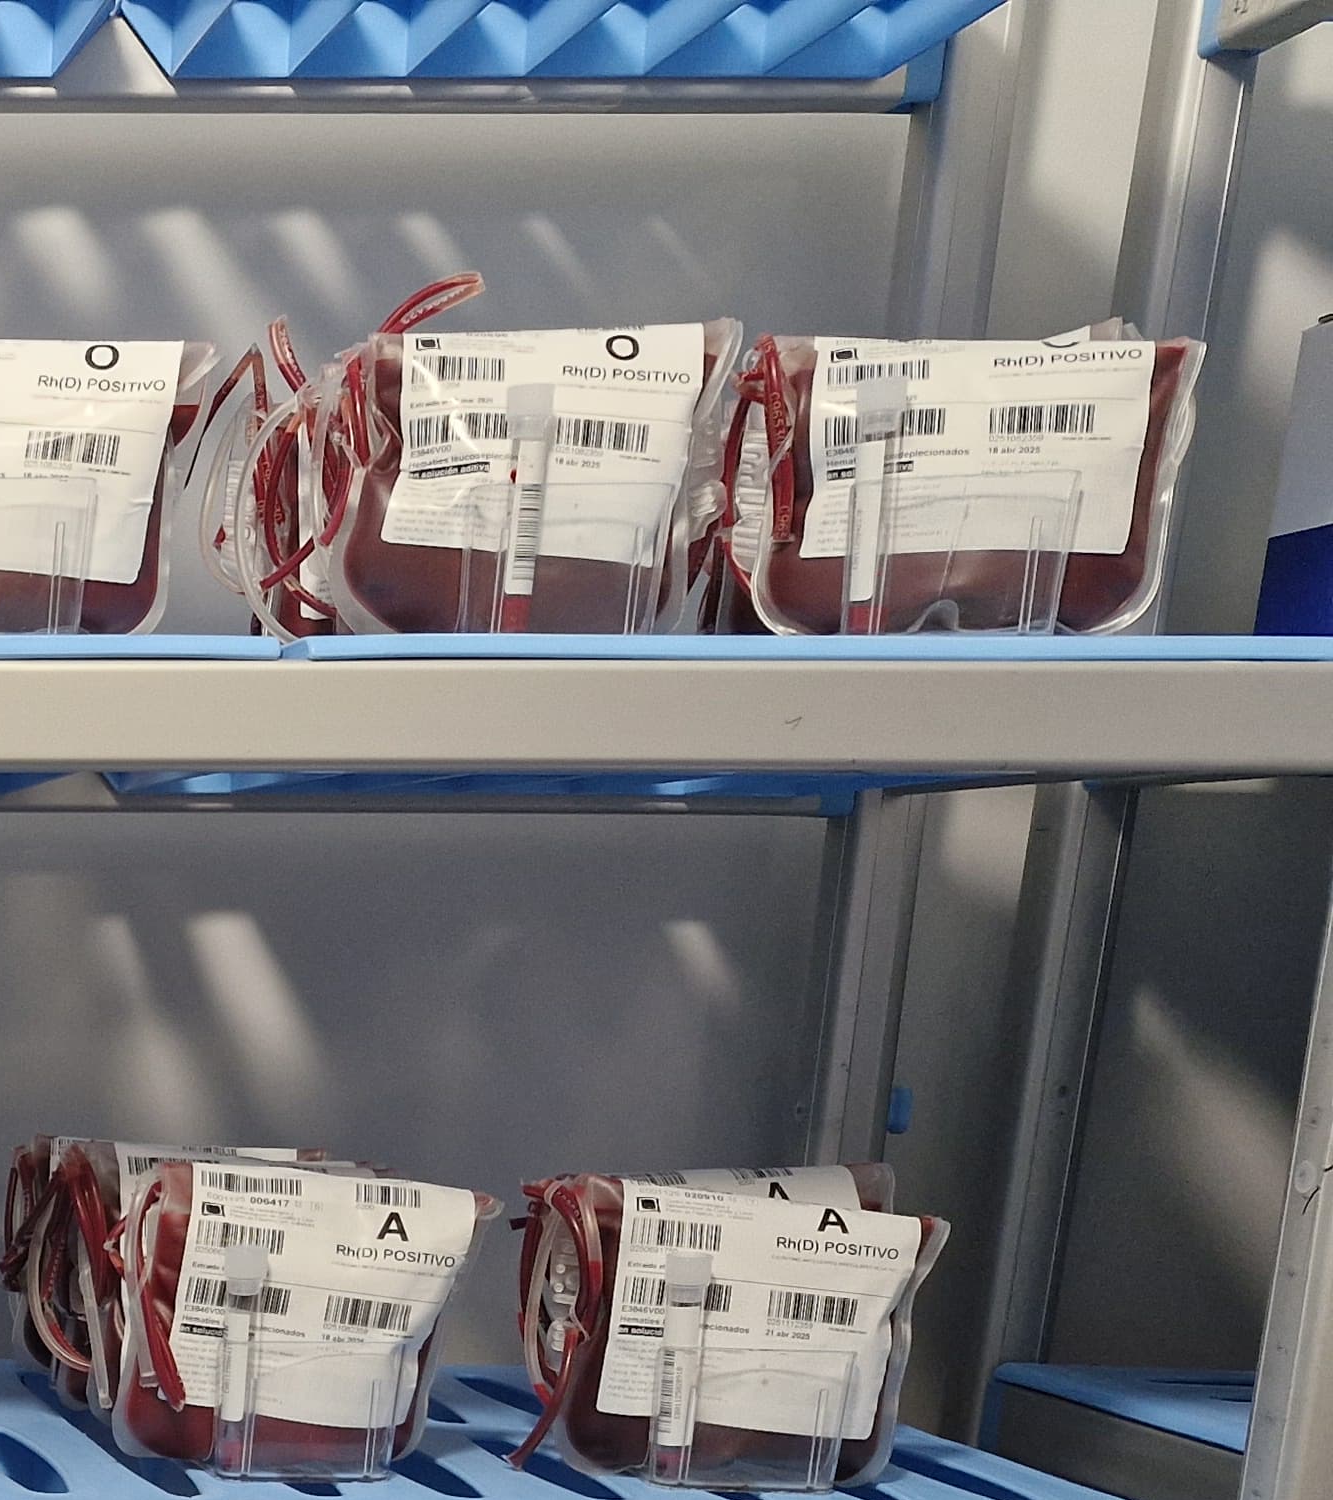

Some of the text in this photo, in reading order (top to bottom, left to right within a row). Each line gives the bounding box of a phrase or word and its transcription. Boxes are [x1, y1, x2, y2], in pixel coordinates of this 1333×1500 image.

[85, 344, 119, 370] O
[605, 334, 640, 360] O
[993, 348, 1143, 368] Rh(D) POSITIVO
[37, 375, 166, 393] Rh(D) POSITIVO
[562, 364, 691, 384] Rh(D) POSITIVO
[1016, 446, 1041, 455] 2025
[249, 1195, 290, 1209] 006417
[376, 1212, 410, 1242] A
[817, 1208, 849, 1234] A
[336, 1243, 456, 1268] Rh(D) POSITIVO
[776, 1236, 900, 1261] Rh(D) POSITIVO
[792, 1331, 811, 1340] 2025
